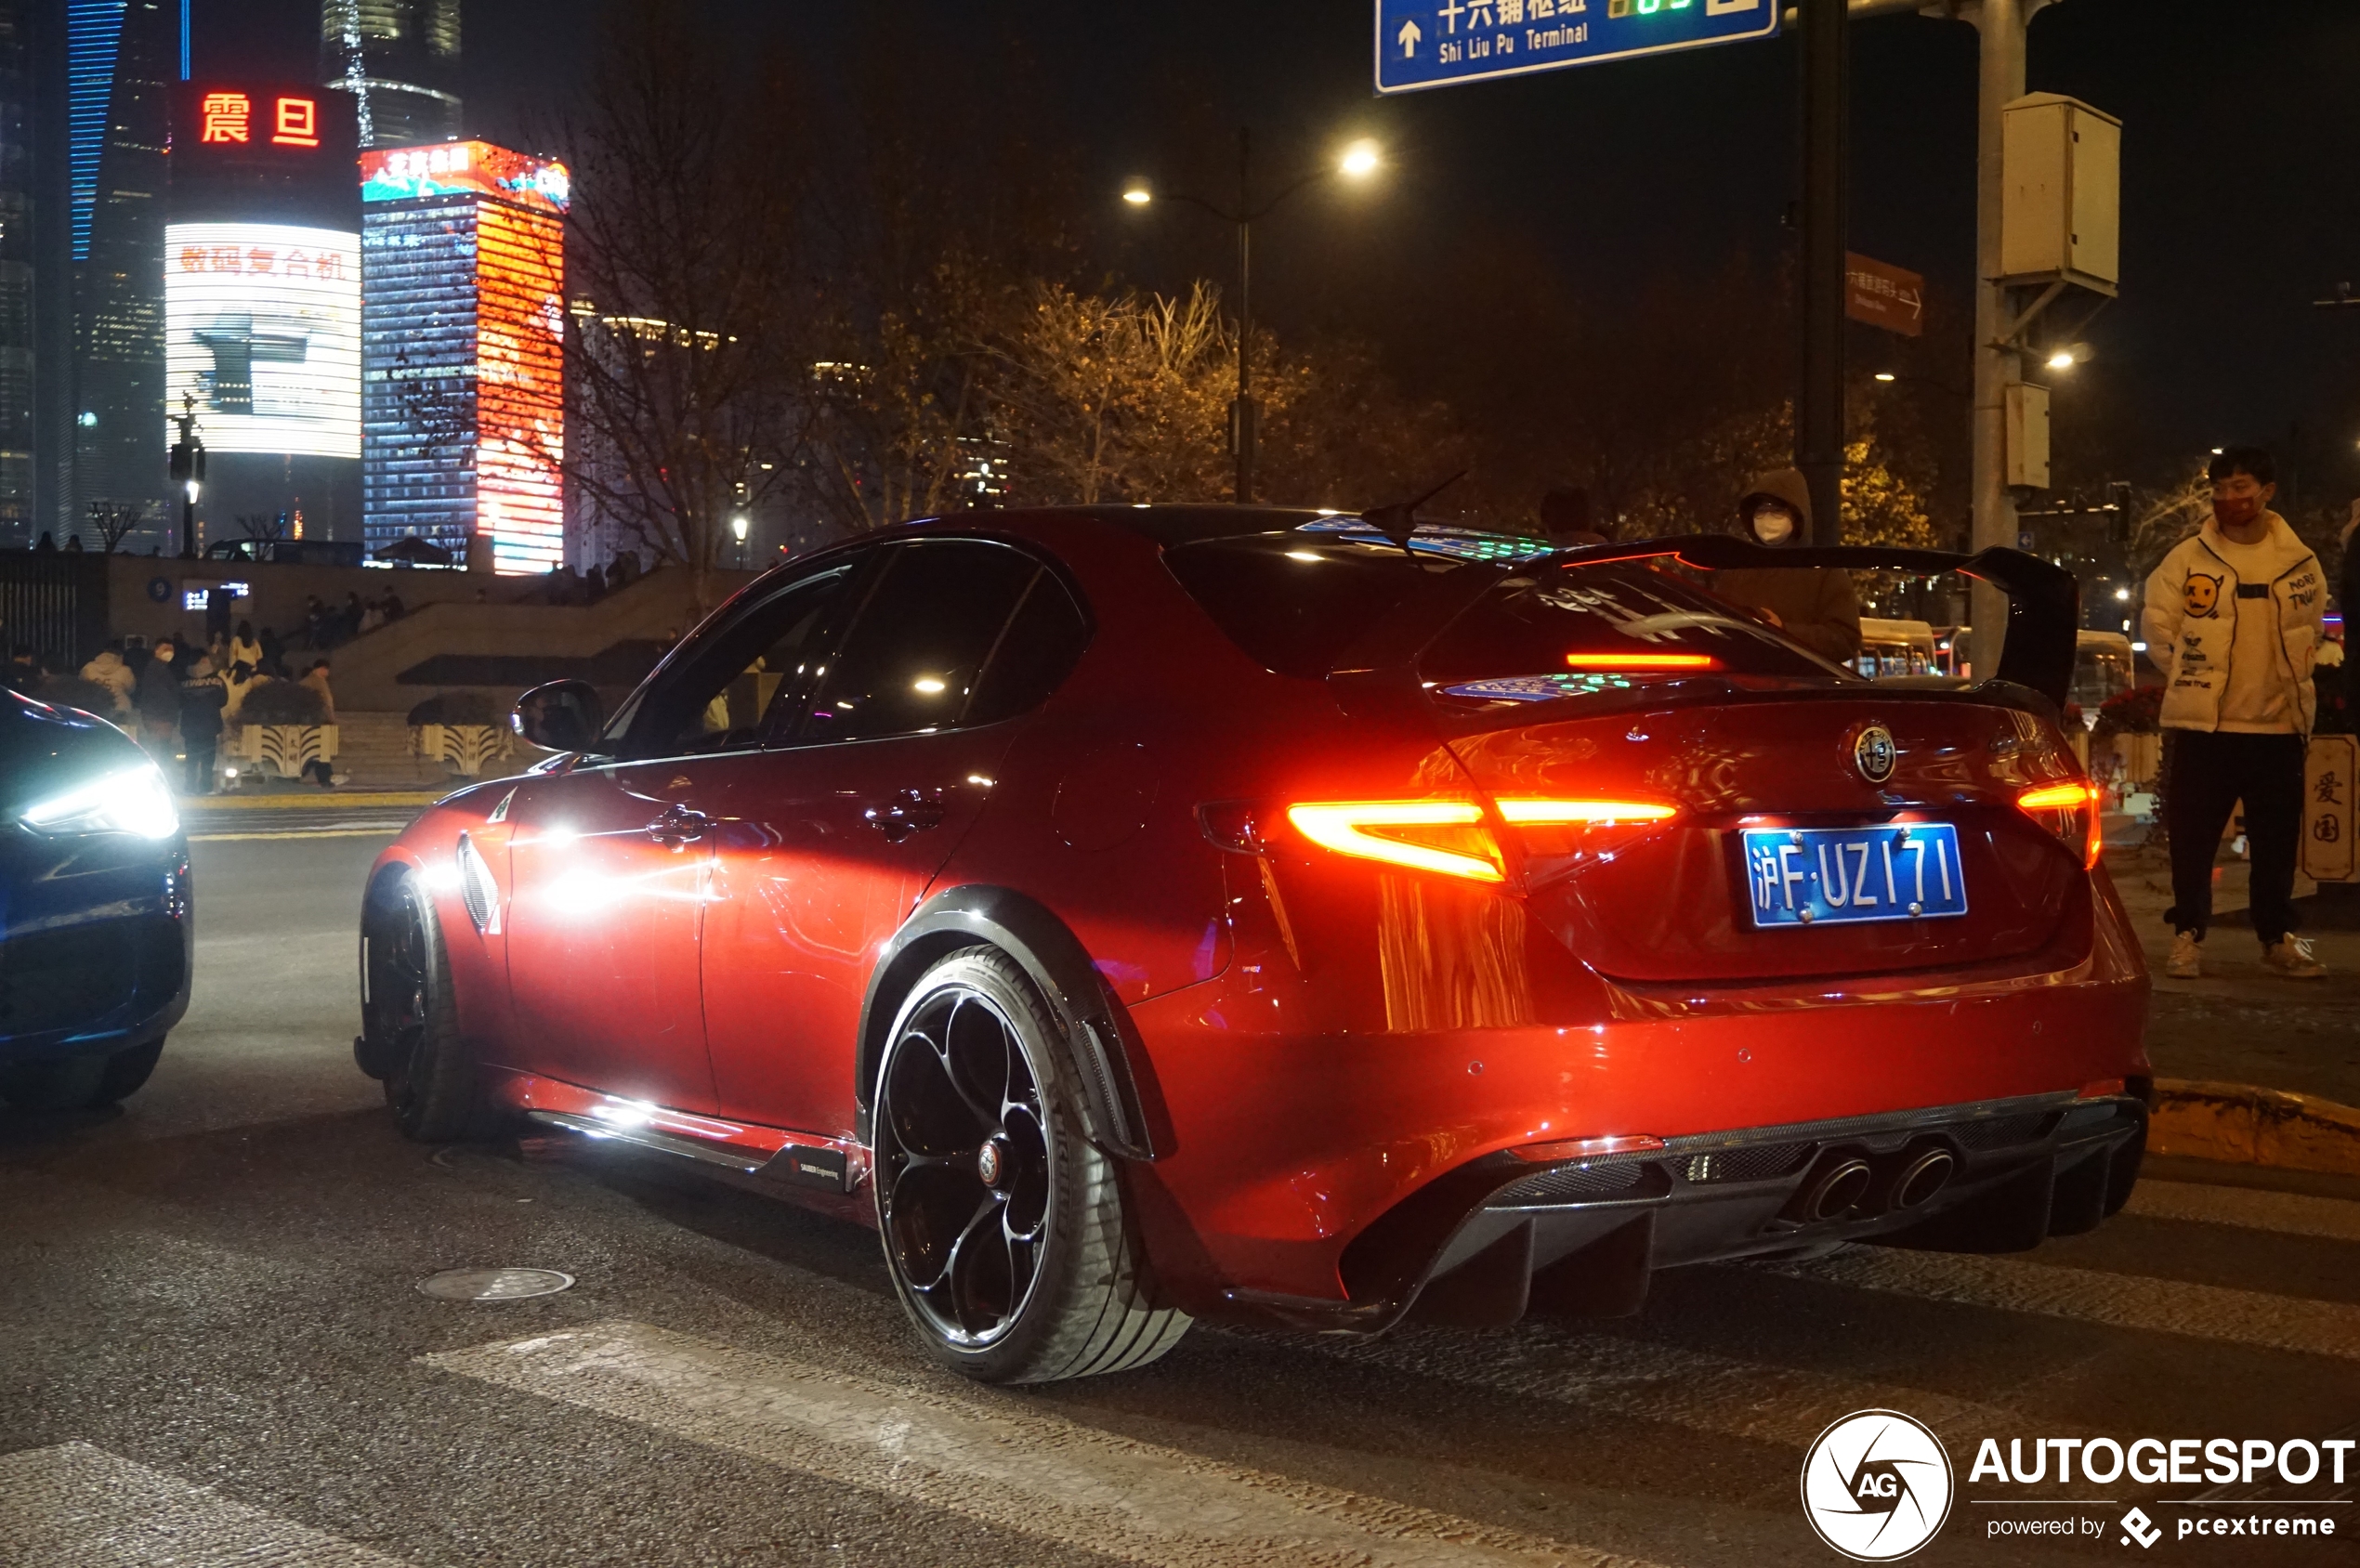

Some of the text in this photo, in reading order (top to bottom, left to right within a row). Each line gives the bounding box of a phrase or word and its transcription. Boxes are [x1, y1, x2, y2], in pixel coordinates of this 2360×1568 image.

[1439, 22, 1588, 64] Shi Liu Pu Terminal
[202, 92, 320, 147] 震旦
[180, 245, 346, 281] 数码复合机
[800, 1163, 817, 1174] SAUBER
